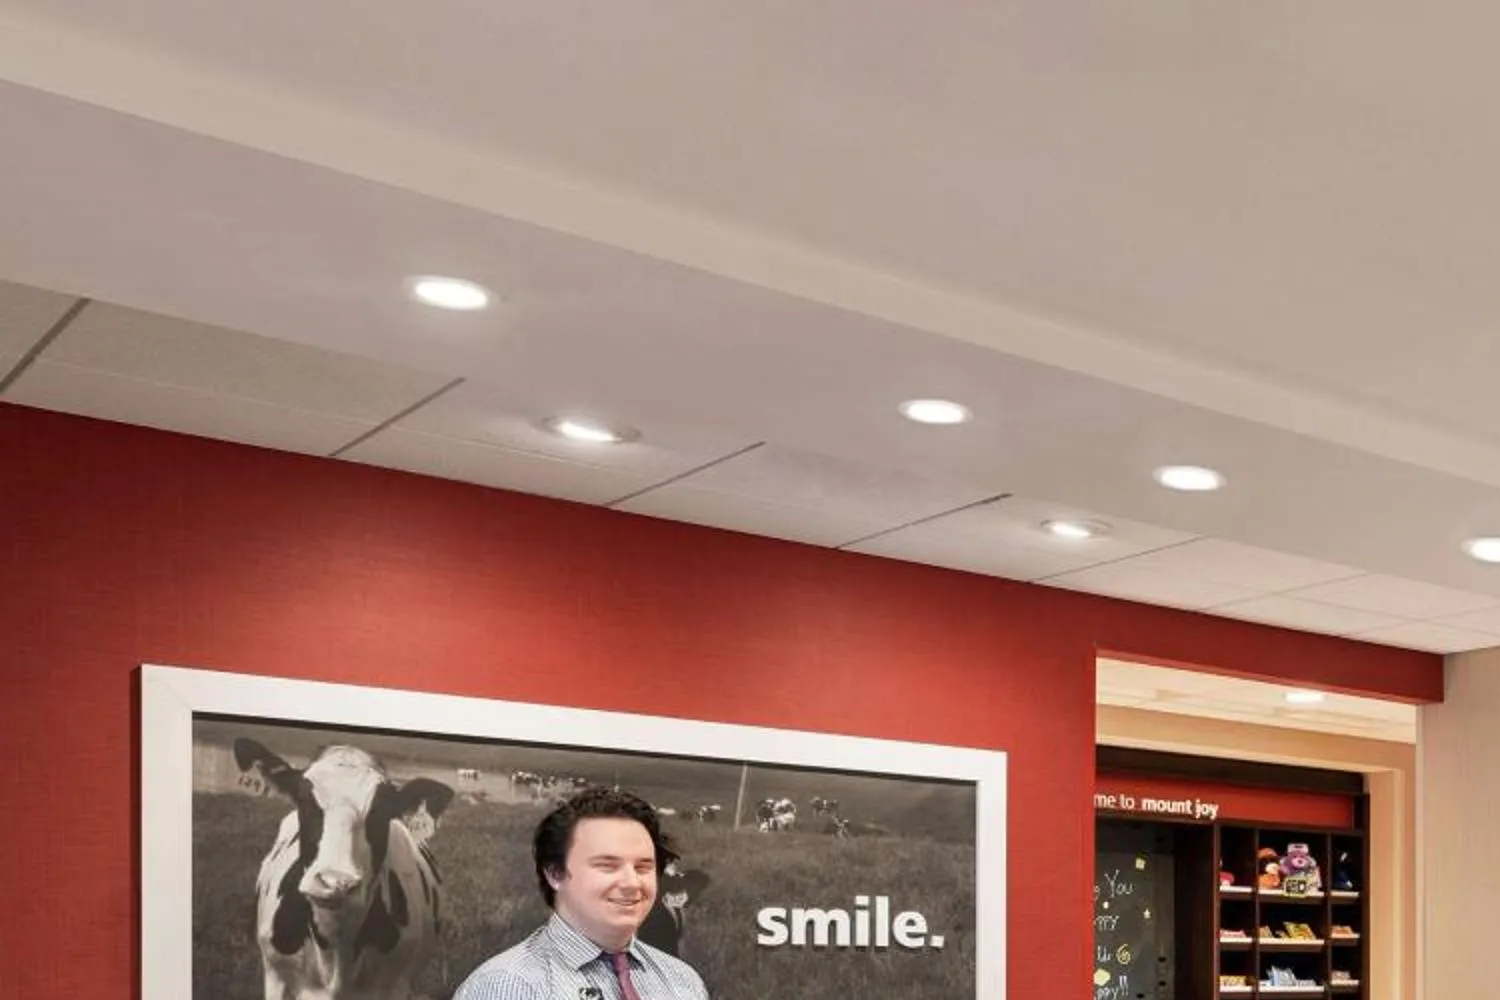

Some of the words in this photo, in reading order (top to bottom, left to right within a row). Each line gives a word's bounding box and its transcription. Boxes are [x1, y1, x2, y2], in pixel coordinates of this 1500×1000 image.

[1120, 794, 1135, 810] to
[1142, 798, 1192, 814] mount
[1196, 799, 1219, 820] joy
[757, 895, 945, 949] smile.
